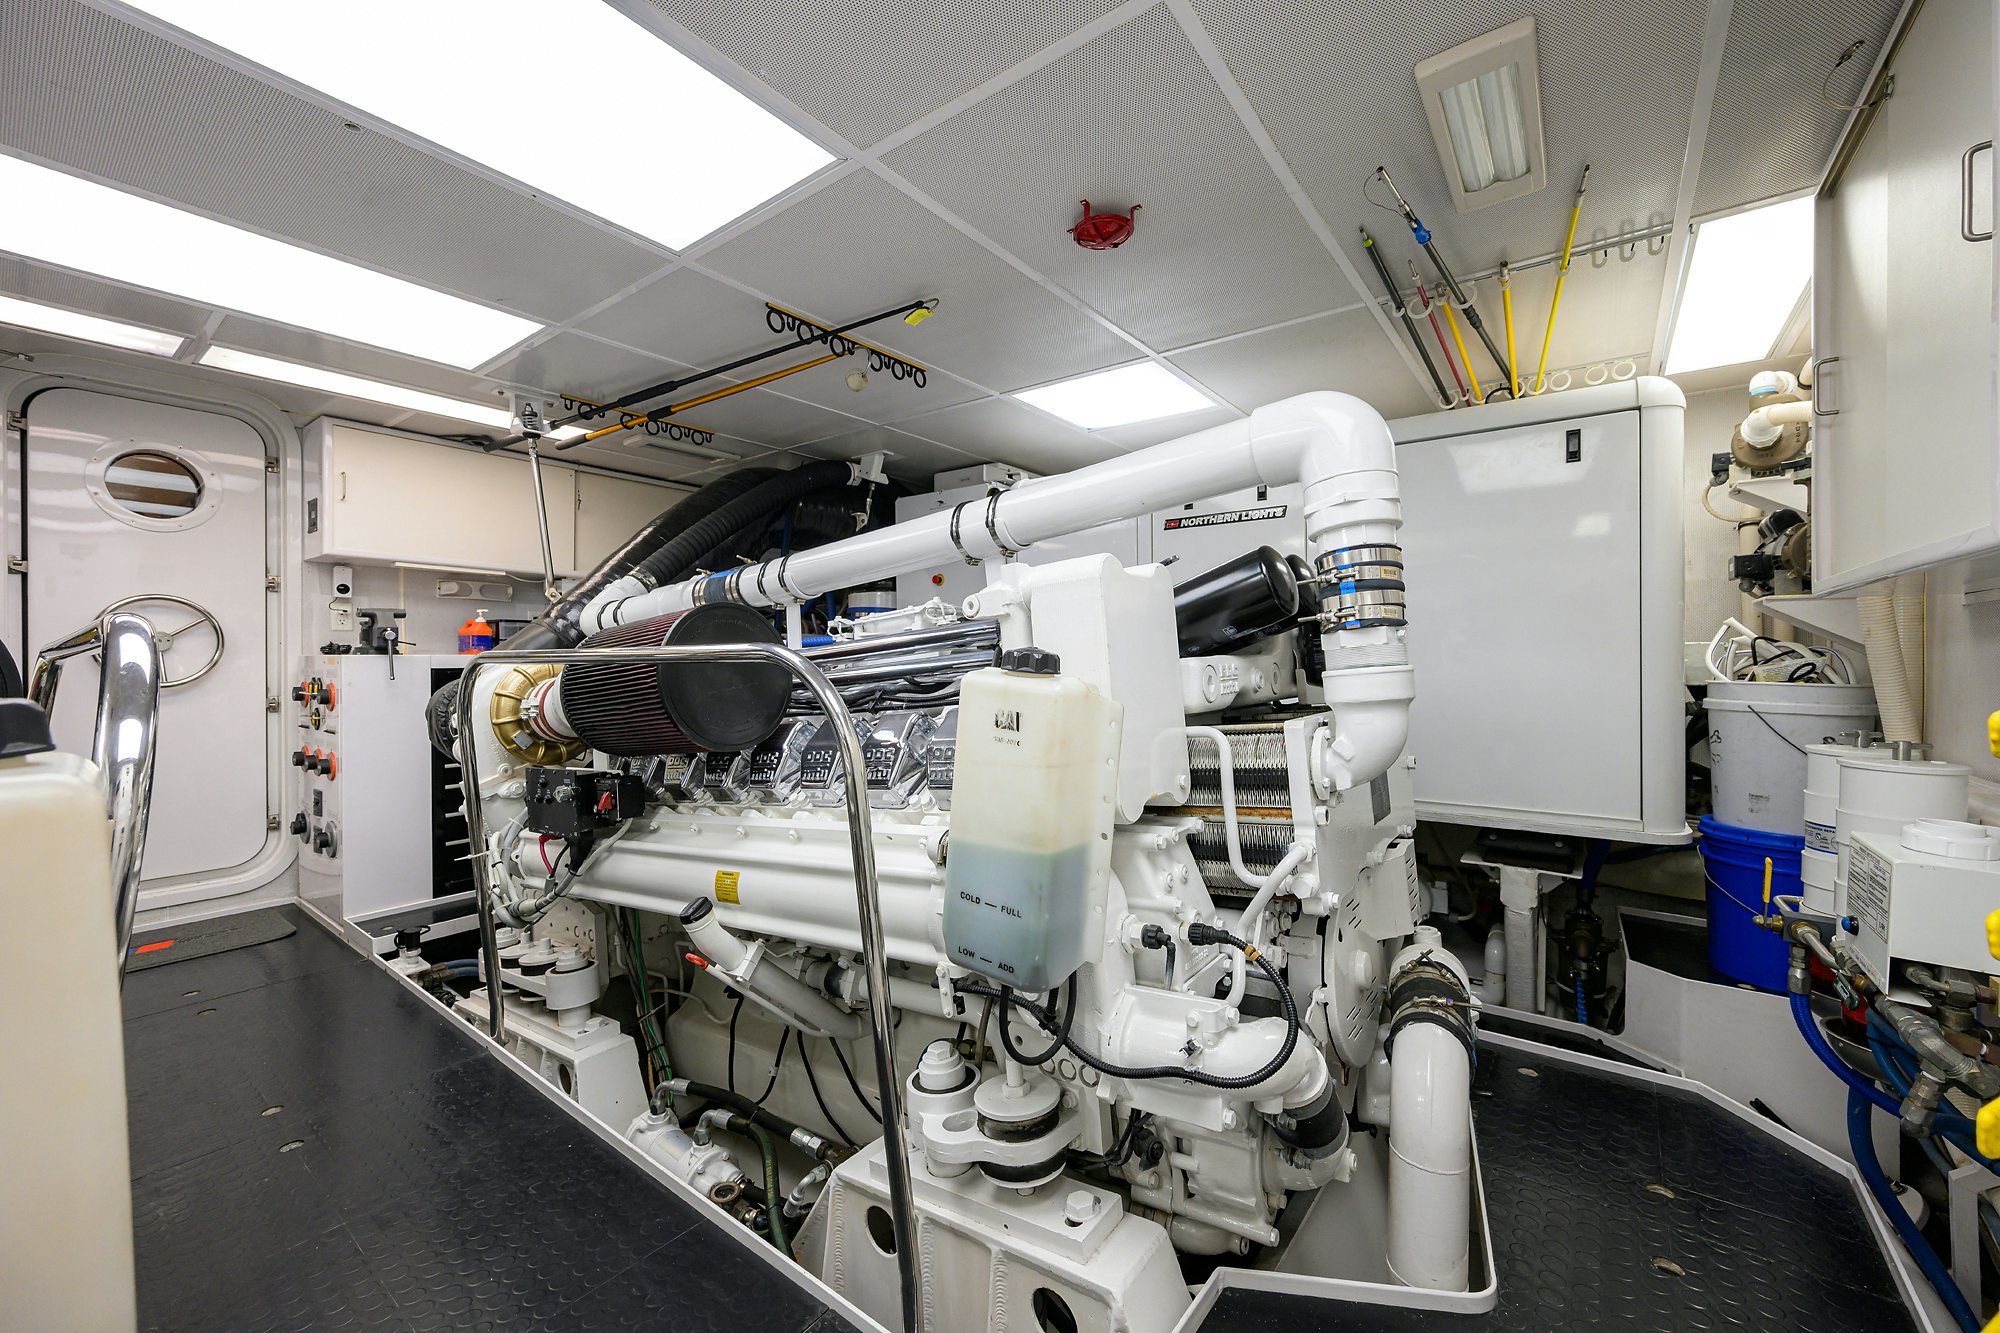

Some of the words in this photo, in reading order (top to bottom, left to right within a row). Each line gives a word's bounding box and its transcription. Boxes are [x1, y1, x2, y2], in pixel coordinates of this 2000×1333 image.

[1180, 512, 1240, 528] NORTHERN
[1241, 506, 1285, 521] LIGHTS
[960, 891, 981, 905] COLD
[1001, 905, 1022, 919] FULL
[958, 945, 976, 959] LOW
[997, 962, 1015, 975] ADD
